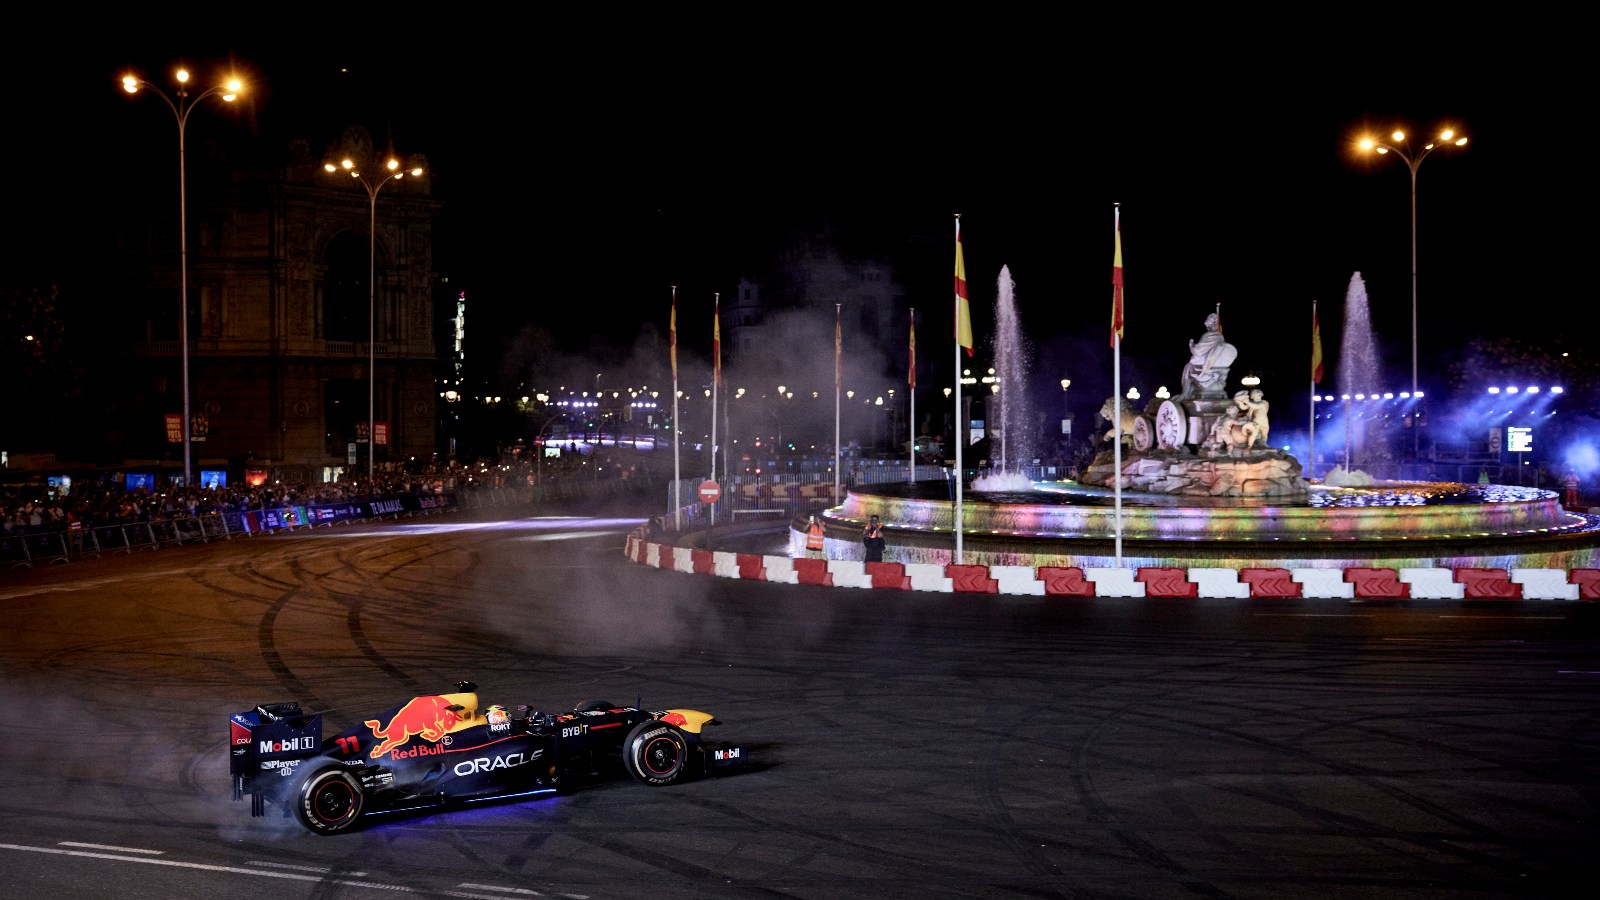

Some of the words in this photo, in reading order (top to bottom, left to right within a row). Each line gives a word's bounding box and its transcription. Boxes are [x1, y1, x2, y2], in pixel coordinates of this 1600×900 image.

[490, 723, 511, 732] ROKT
[562, 723, 589, 738] BYBIT
[260, 737, 299, 754] Mobil
[335, 735, 360, 757] 11
[391, 745, 418, 761] Red
[418, 743, 445, 758] Bull
[714, 747, 740, 761] Mobil
[270, 759, 301, 769] Player
[454, 748, 544, 777] ORACLE
